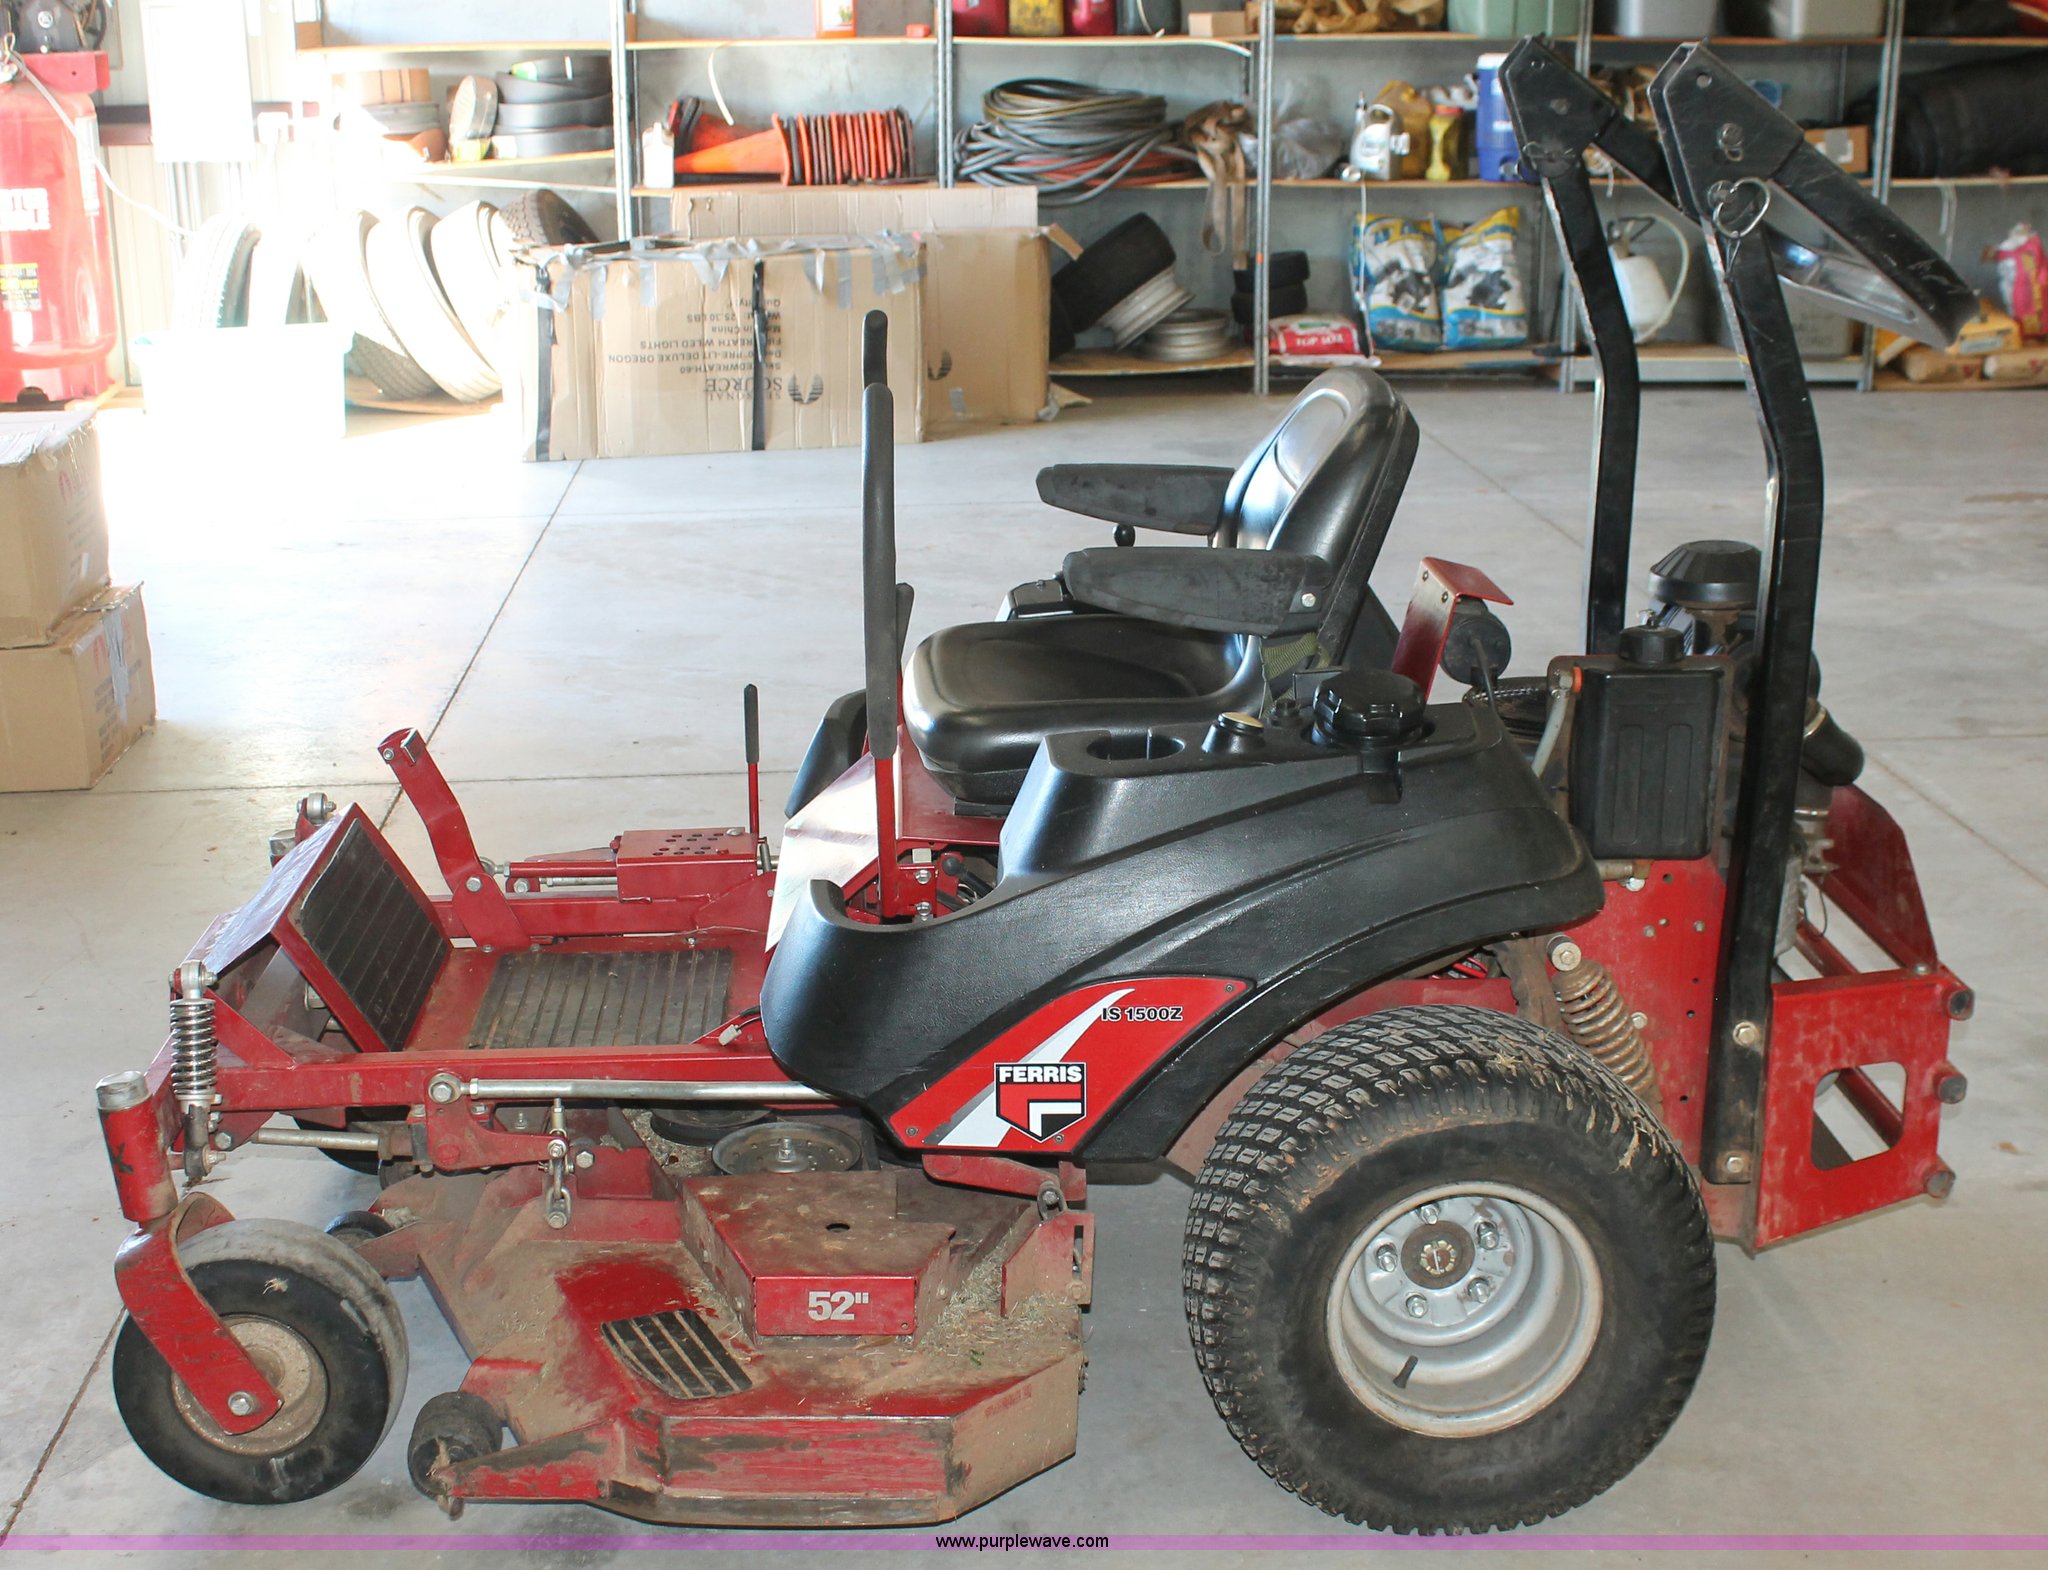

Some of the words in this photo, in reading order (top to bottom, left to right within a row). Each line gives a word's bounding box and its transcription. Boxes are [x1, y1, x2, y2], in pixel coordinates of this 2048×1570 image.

[712, 326, 741, 335] China
[640, 340, 679, 350] LIGHTS
[718, 338, 753, 347] REATH
[608, 354, 655, 364] OREGON
[657, 352, 699, 363] DELUXE
[702, 352, 743, 360] PRE-LIT
[1101, 1006, 1121, 1022] IS
[1125, 1006, 1184, 1022] 1500Z
[998, 1065, 1083, 1083] FERRIS
[807, 1290, 869, 1321] 52"
